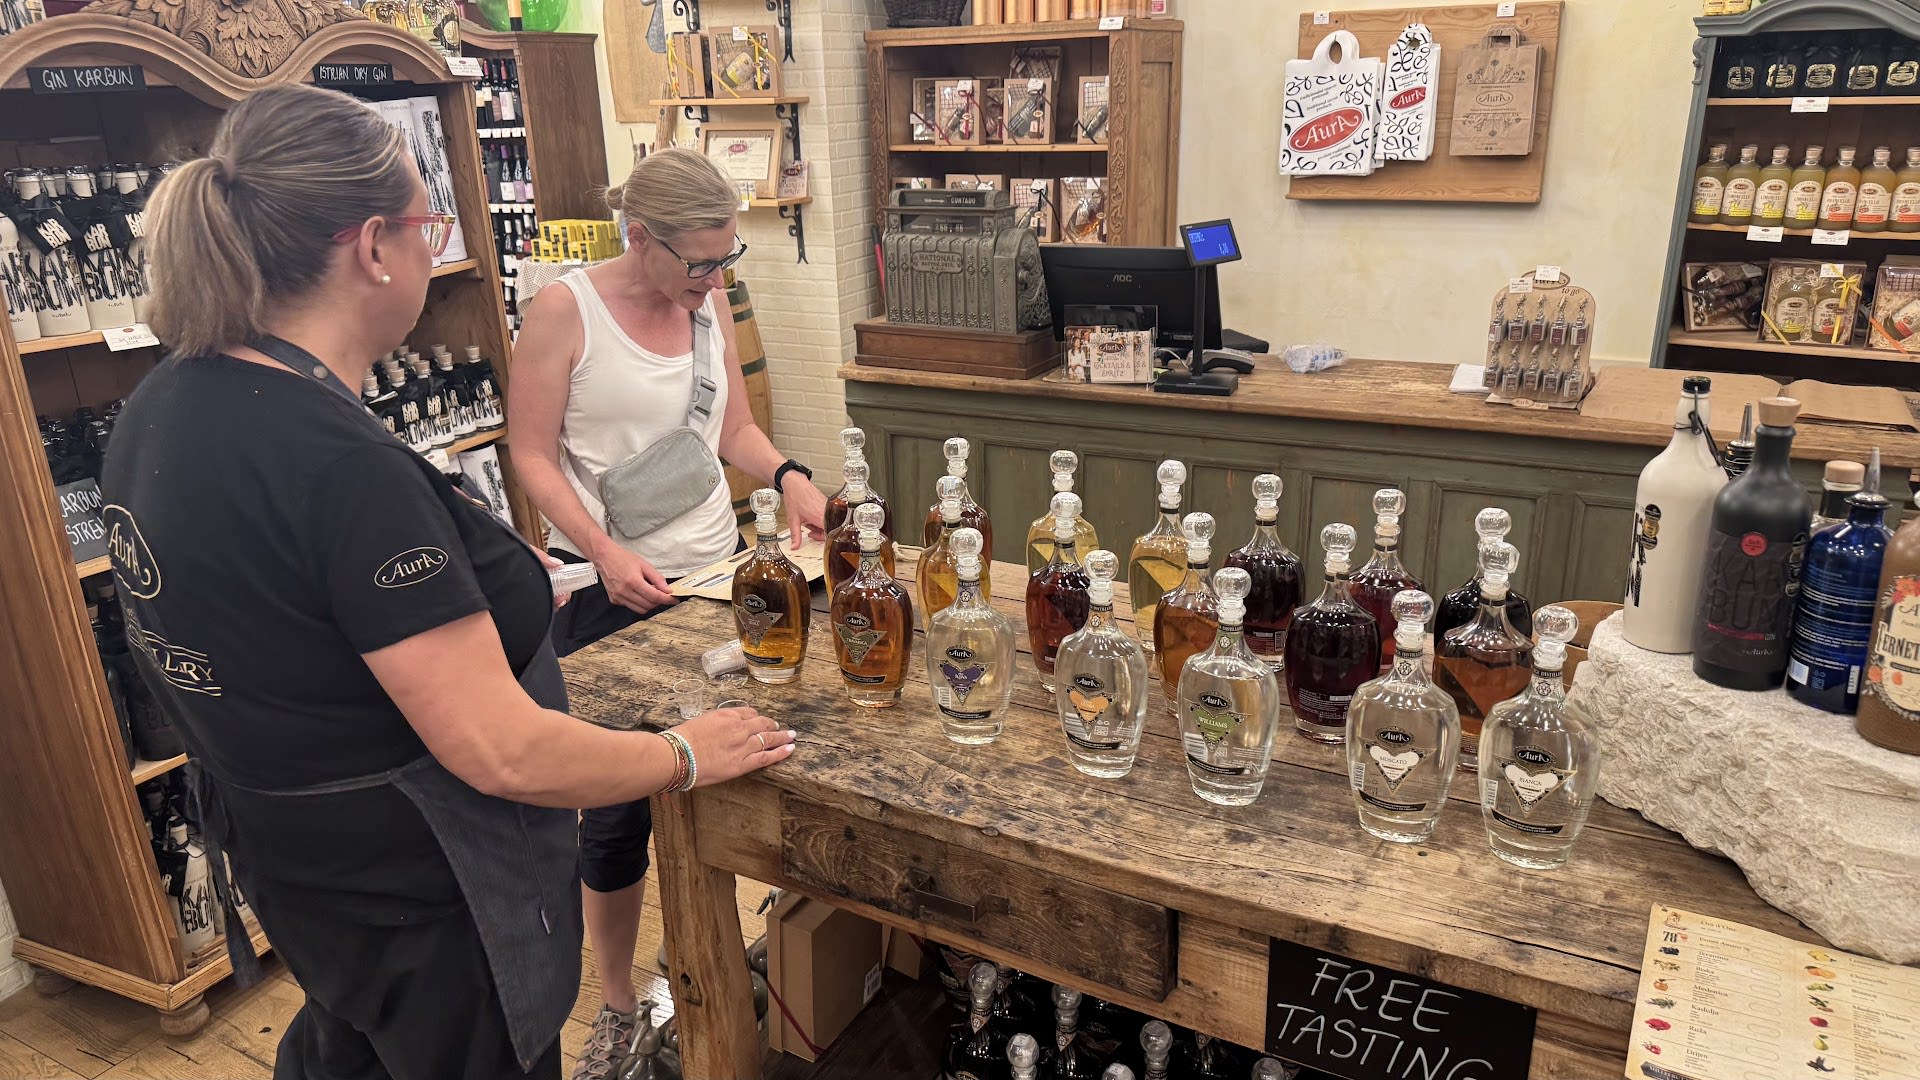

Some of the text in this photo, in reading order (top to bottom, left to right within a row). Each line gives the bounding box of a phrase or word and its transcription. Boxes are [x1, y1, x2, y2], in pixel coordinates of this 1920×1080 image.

[42, 65, 134, 90] GIN KARBUN
[319, 65, 387, 84] ISTRIAN DRY GIN
[1294, 115, 1360, 148] AurA
[1113, 274, 1133, 282] AOC
[60, 484, 103, 518] ARBUN
[381, 552, 444, 583] AurA
[1199, 715, 1228, 729] WILLIAMS
[1662, 930, 1678, 943] 78
[1310, 957, 1463, 1033] FREE
